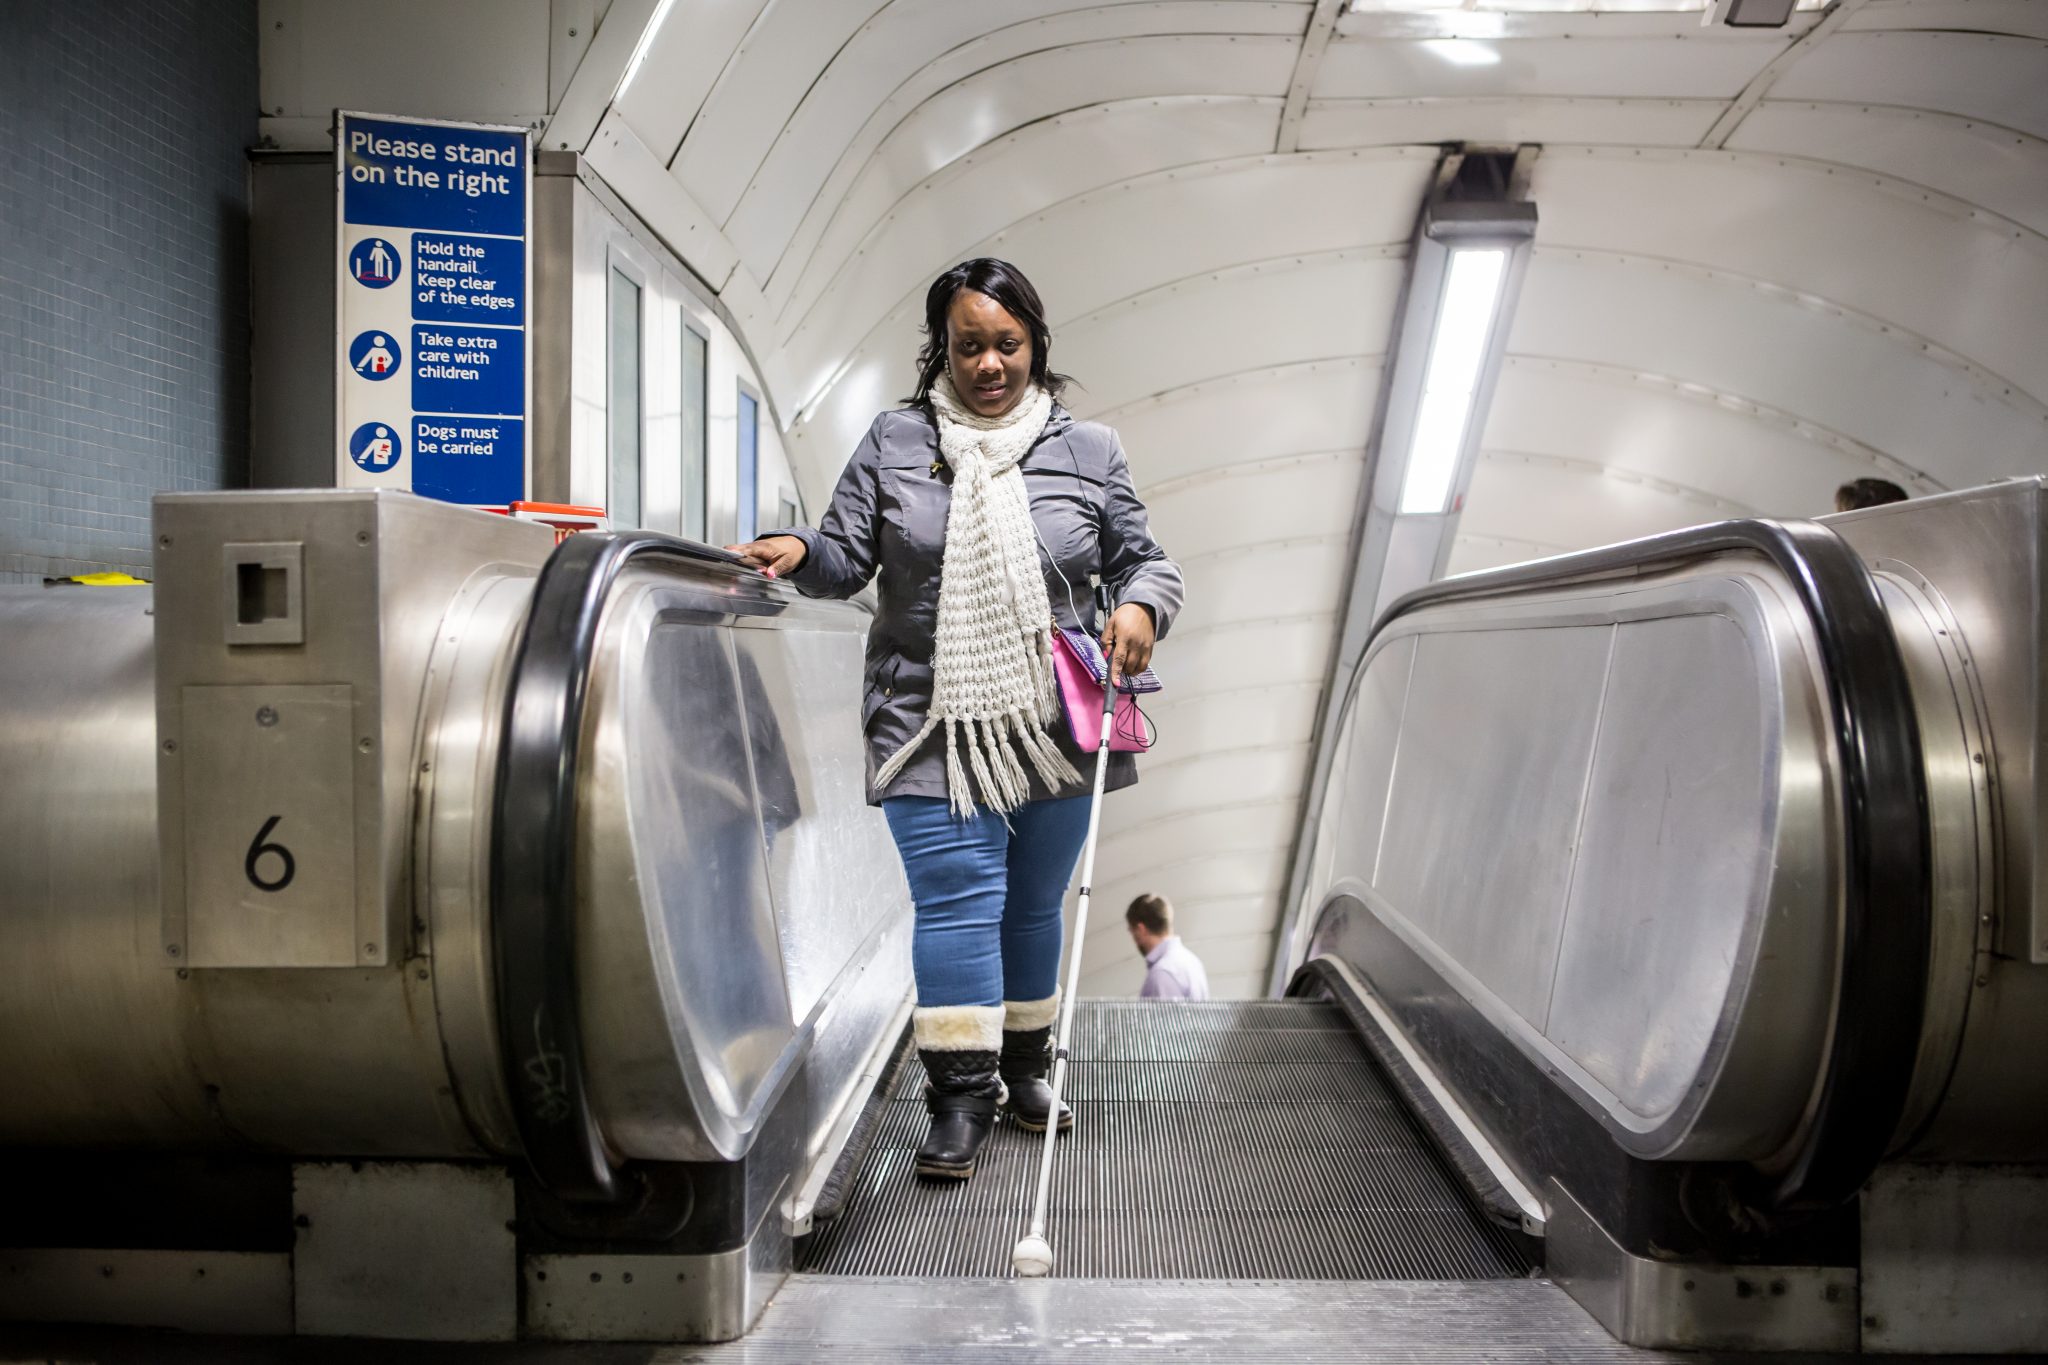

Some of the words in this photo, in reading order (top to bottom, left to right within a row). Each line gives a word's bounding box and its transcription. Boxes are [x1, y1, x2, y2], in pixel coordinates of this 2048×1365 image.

[351, 131, 436, 161] Please
[444, 144, 516, 167] stand
[351, 165, 385, 184] on
[394, 165, 440, 188] the
[447, 169, 510, 197] right
[417, 240, 454, 256] Hold
[458, 244, 485, 258] the
[417, 257, 478, 273] handrail
[417, 273, 457, 291] Keep
[460, 276, 497, 290] clear
[418, 290, 437, 303] of
[439, 291, 467, 305] the
[470, 294, 516, 310] edges
[418, 332, 454, 347] Take
[457, 336, 498, 349] extra
[418, 351, 450, 362] care
[454, 351, 490, 365] with
[418, 365, 480, 380] children
[418, 423, 458, 441] Dogs
[460, 427, 500, 440] must
[418, 440, 438, 453] be
[441, 441, 494, 456] carried
[245, 815, 296, 893] 6
